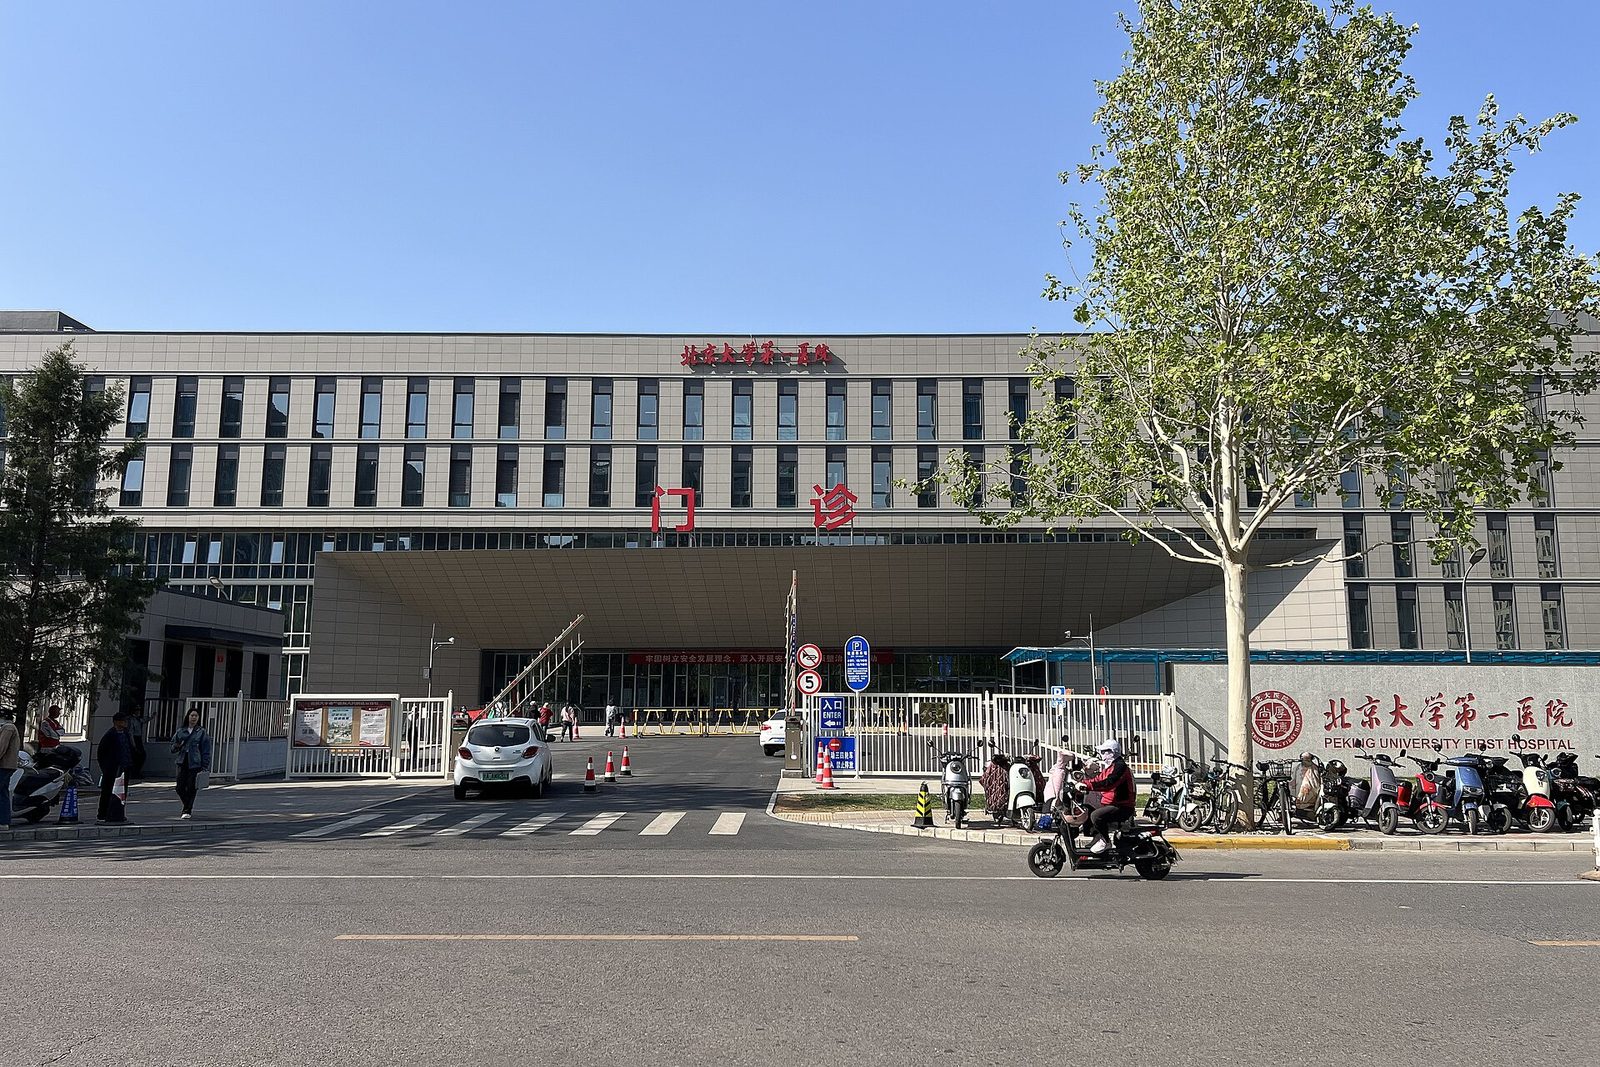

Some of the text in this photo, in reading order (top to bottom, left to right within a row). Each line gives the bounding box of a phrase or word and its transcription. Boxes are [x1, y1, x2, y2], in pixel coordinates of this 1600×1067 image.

[681, 340, 833, 366] 北京大学第一医院
[805, 676, 814, 689] 5
[823, 699, 842, 710] 入口
[823, 711, 842, 719] ENTER
[1323, 692, 1574, 732] 北京大学第一医院
[1379, 738, 1461, 750] UNIVERSITY
[1465, 738, 1504, 750] FIRST
[1508, 738, 1575, 750] HOSPITAL
